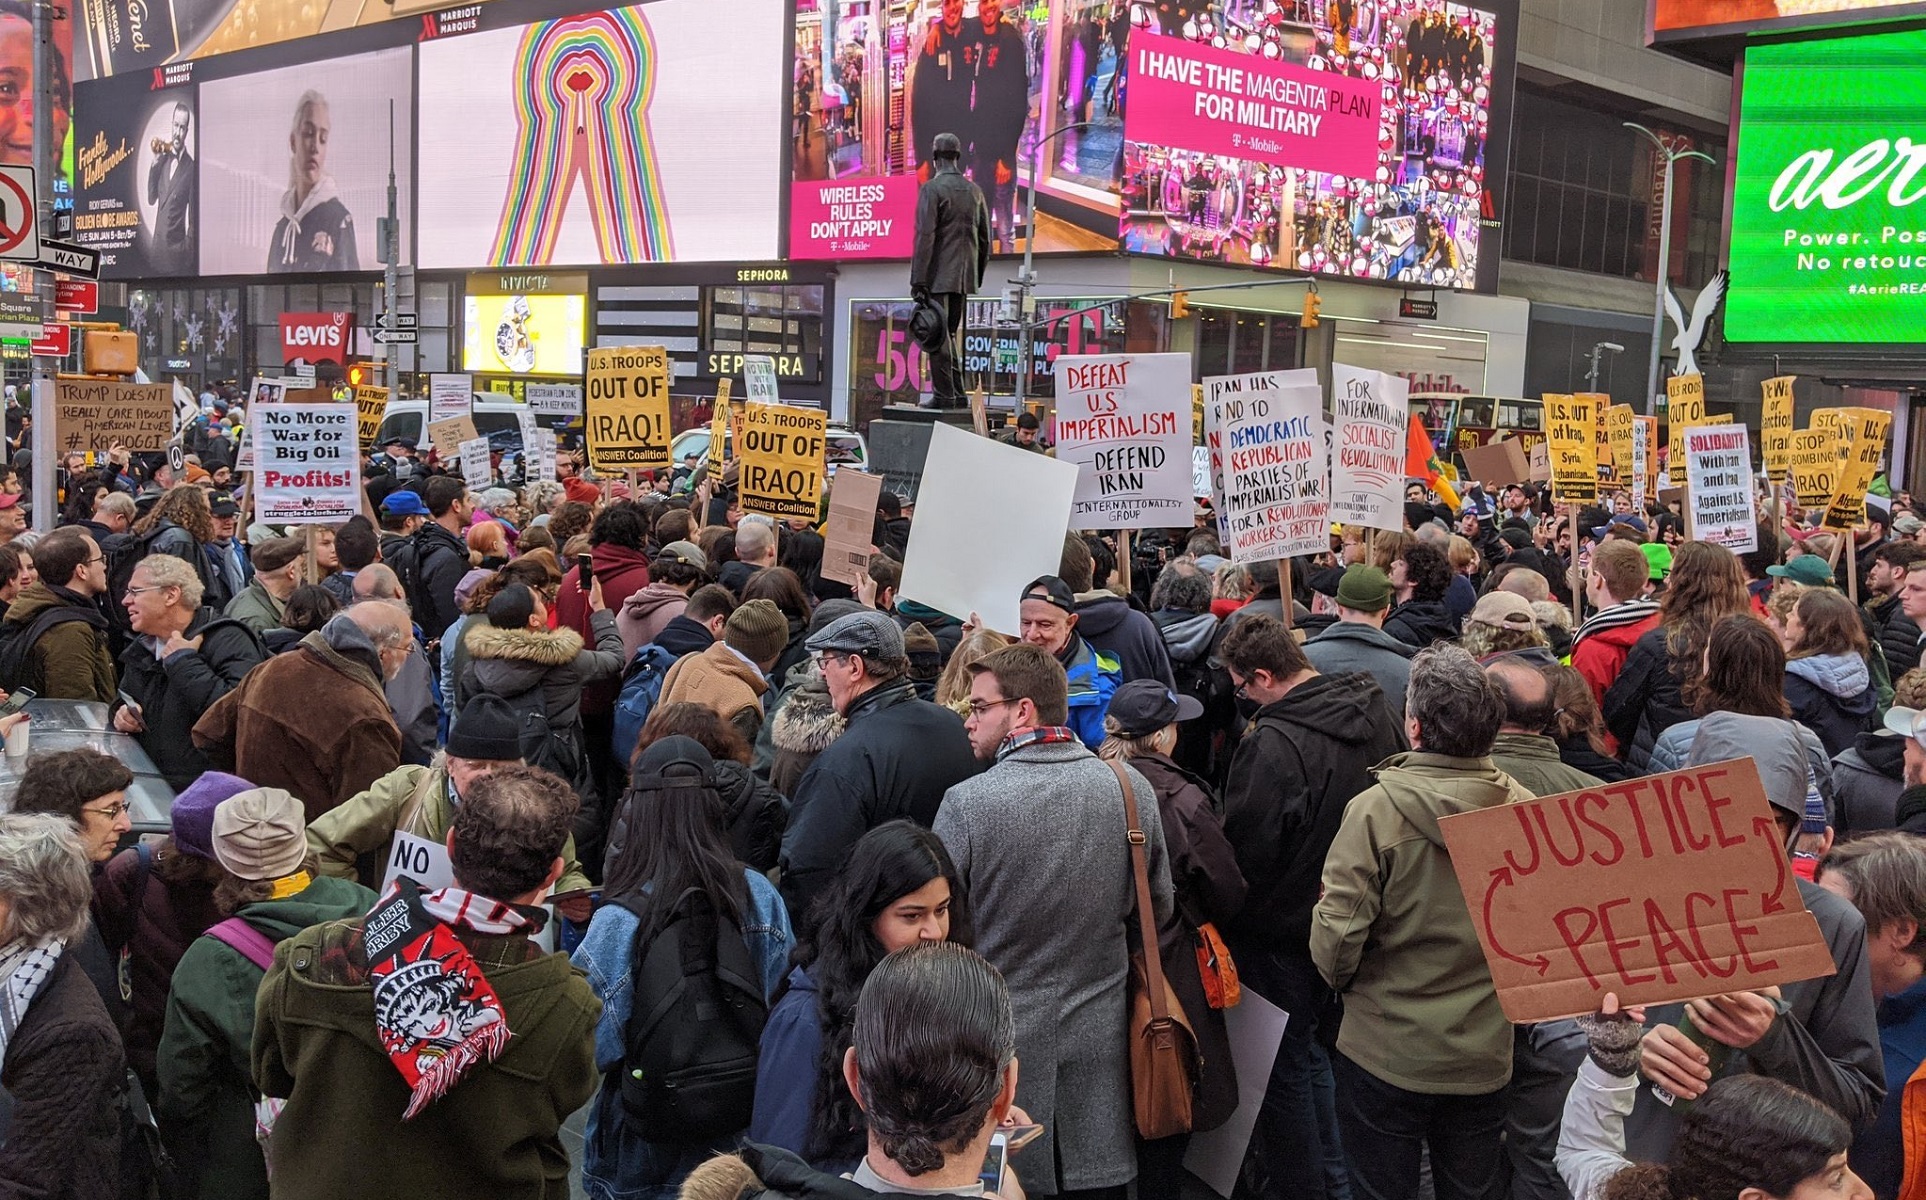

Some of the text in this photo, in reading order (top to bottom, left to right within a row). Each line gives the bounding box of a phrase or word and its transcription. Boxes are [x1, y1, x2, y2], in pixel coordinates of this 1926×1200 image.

[440, 6, 482, 22] MARRIOTT
[440, 19, 477, 34] MARQUIS
[165, 62, 194, 75] MARRIOTT
[165, 73, 191, 85] MARQUIS
[1139, 49, 1371, 120] I HAVE THE MAGENTA PLAN
[1194, 91, 1322, 138] FOR MILITARY
[79, 131, 109, 171] Frankly,
[1768, 136, 1926, 213] aer
[819, 184, 885, 205] WIRELESS
[76, 214, 96, 230] GOLDEN
[116, 211, 138, 227] AWARDS
[830, 203, 873, 221] RULES
[77, 232, 88, 242] LIVE
[88, 232, 100, 241] SUN
[100, 231, 111, 241] JAN
[851, 219, 893, 237] APPLY
[1783, 229, 1870, 247] Power.
[55, 250, 87, 267] WAY
[1797, 253, 1831, 271] No
[500, 275, 551, 291] INVICTA
[737, 269, 789, 282] SEPHORA
[1, 303, 32, 313] Square
[19, 313, 40, 322] Plaza
[590, 355, 662, 371] U.S. TROOPS
[708, 354, 804, 376] SEPRA
[1067, 361, 1130, 390] DEFEAT
[60, 385, 109, 402] TRUMP
[496, 384, 510, 393] BUY
[528, 388, 553, 398] PEDESTRIAN
[565, 390, 577, 399] ZONE
[590, 375, 664, 400] OUT OF
[1211, 378, 1242, 402] IRAN
[1346, 378, 1372, 401] FOR
[1086, 391, 1118, 413] U.S.
[1225, 399, 1269, 420] NO TO
[62, 406, 171, 420] REALLY CARE ABOUT
[265, 411, 346, 425] No More
[748, 411, 823, 431] U.S. TROOPS
[1337, 398, 1405, 431] INTERNATIONAL
[1550, 403, 1588, 422] U.S. OUT
[1670, 402, 1688, 424] OUT
[84, 419, 171, 433] AMERICAN LIVES
[592, 413, 662, 447] IRAQ!
[1059, 411, 1177, 440] IMPERIALISM
[1553, 424, 1564, 440] of
[90, 434, 163, 450] KASHOGGI
[271, 429, 343, 442] War for
[745, 430, 788, 454] OUT
[792, 436, 823, 458] OF
[1342, 423, 1398, 451] SOCIALIST
[1690, 432, 1745, 453] SOLIDARITY
[1796, 434, 1825, 451] STOP
[276, 445, 340, 462] Big Oil
[597, 449, 668, 461] ANSWER Coalition
[1095, 445, 1166, 471] DEFEND
[1231, 440, 1313, 475] REPUBLICAN
[1699, 454, 1740, 470] With Iran
[1791, 452, 1834, 466] BOMBING
[264, 470, 352, 488] Profits!
[743, 464, 816, 502] IRAQ!
[1099, 472, 1144, 495] IRAN
[1235, 464, 1292, 493] PARTIES
[1295, 461, 1311, 482] OF
[1703, 473, 1724, 488] and
[1725, 472, 1739, 488] Iraq
[1795, 472, 1835, 496] IRAQ!
[1227, 474, 1326, 513] IMPERIALIST WAR!
[1351, 493, 1368, 503] CUNY
[1698, 492, 1732, 509] Against
[742, 496, 817, 515] ANSWER Coalition
[1075, 501, 1183, 514] INTERNATIONALIST
[1333, 503, 1380, 513] INTERNATIONALIST
[1108, 510, 1141, 522] GROUP
[1231, 502, 1330, 533] FOR A REVOLUTIONARY
[1236, 525, 1287, 549] WORKERS
[1503, 769, 1746, 876] JUSTICE
[393, 839, 430, 875] NO
[1552, 889, 1780, 990] PEACE
